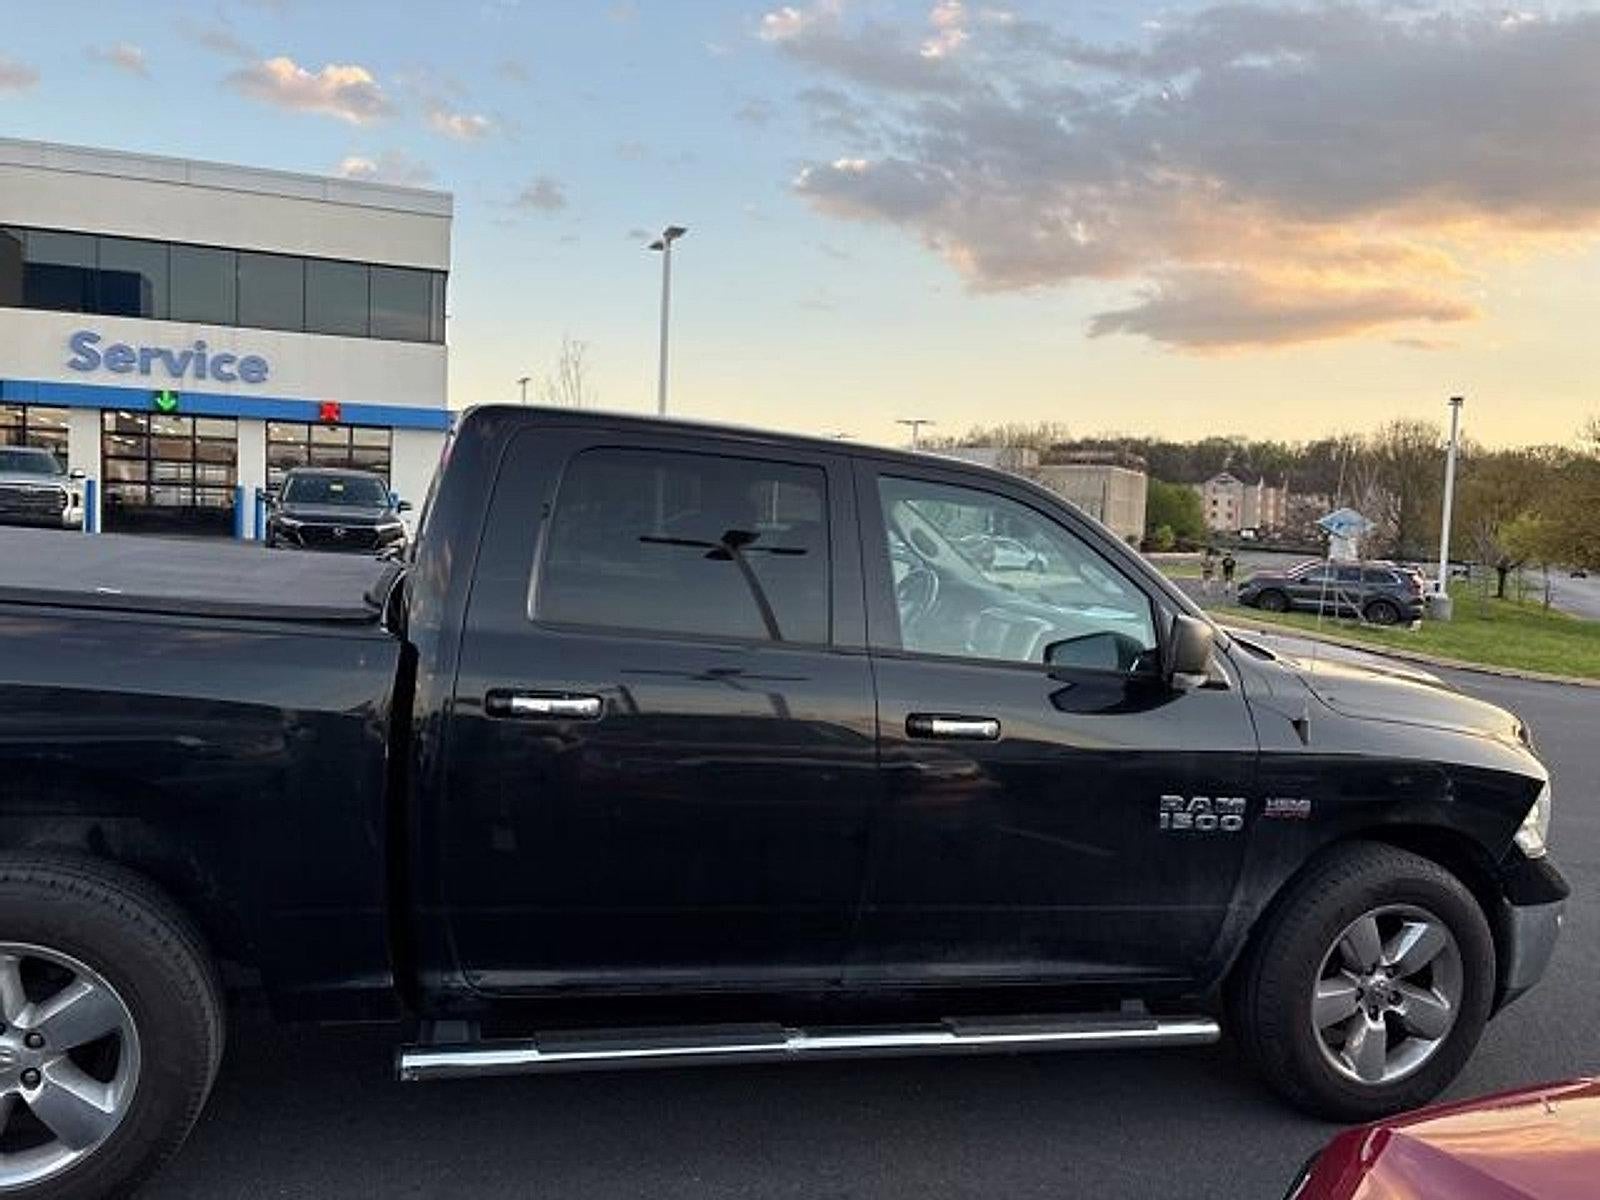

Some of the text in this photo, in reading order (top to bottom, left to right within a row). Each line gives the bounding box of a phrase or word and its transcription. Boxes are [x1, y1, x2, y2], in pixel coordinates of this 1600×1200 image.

[67, 330, 269, 384] Service
[1160, 795, 1246, 813] RAM
[1160, 813, 1244, 831] 1500
